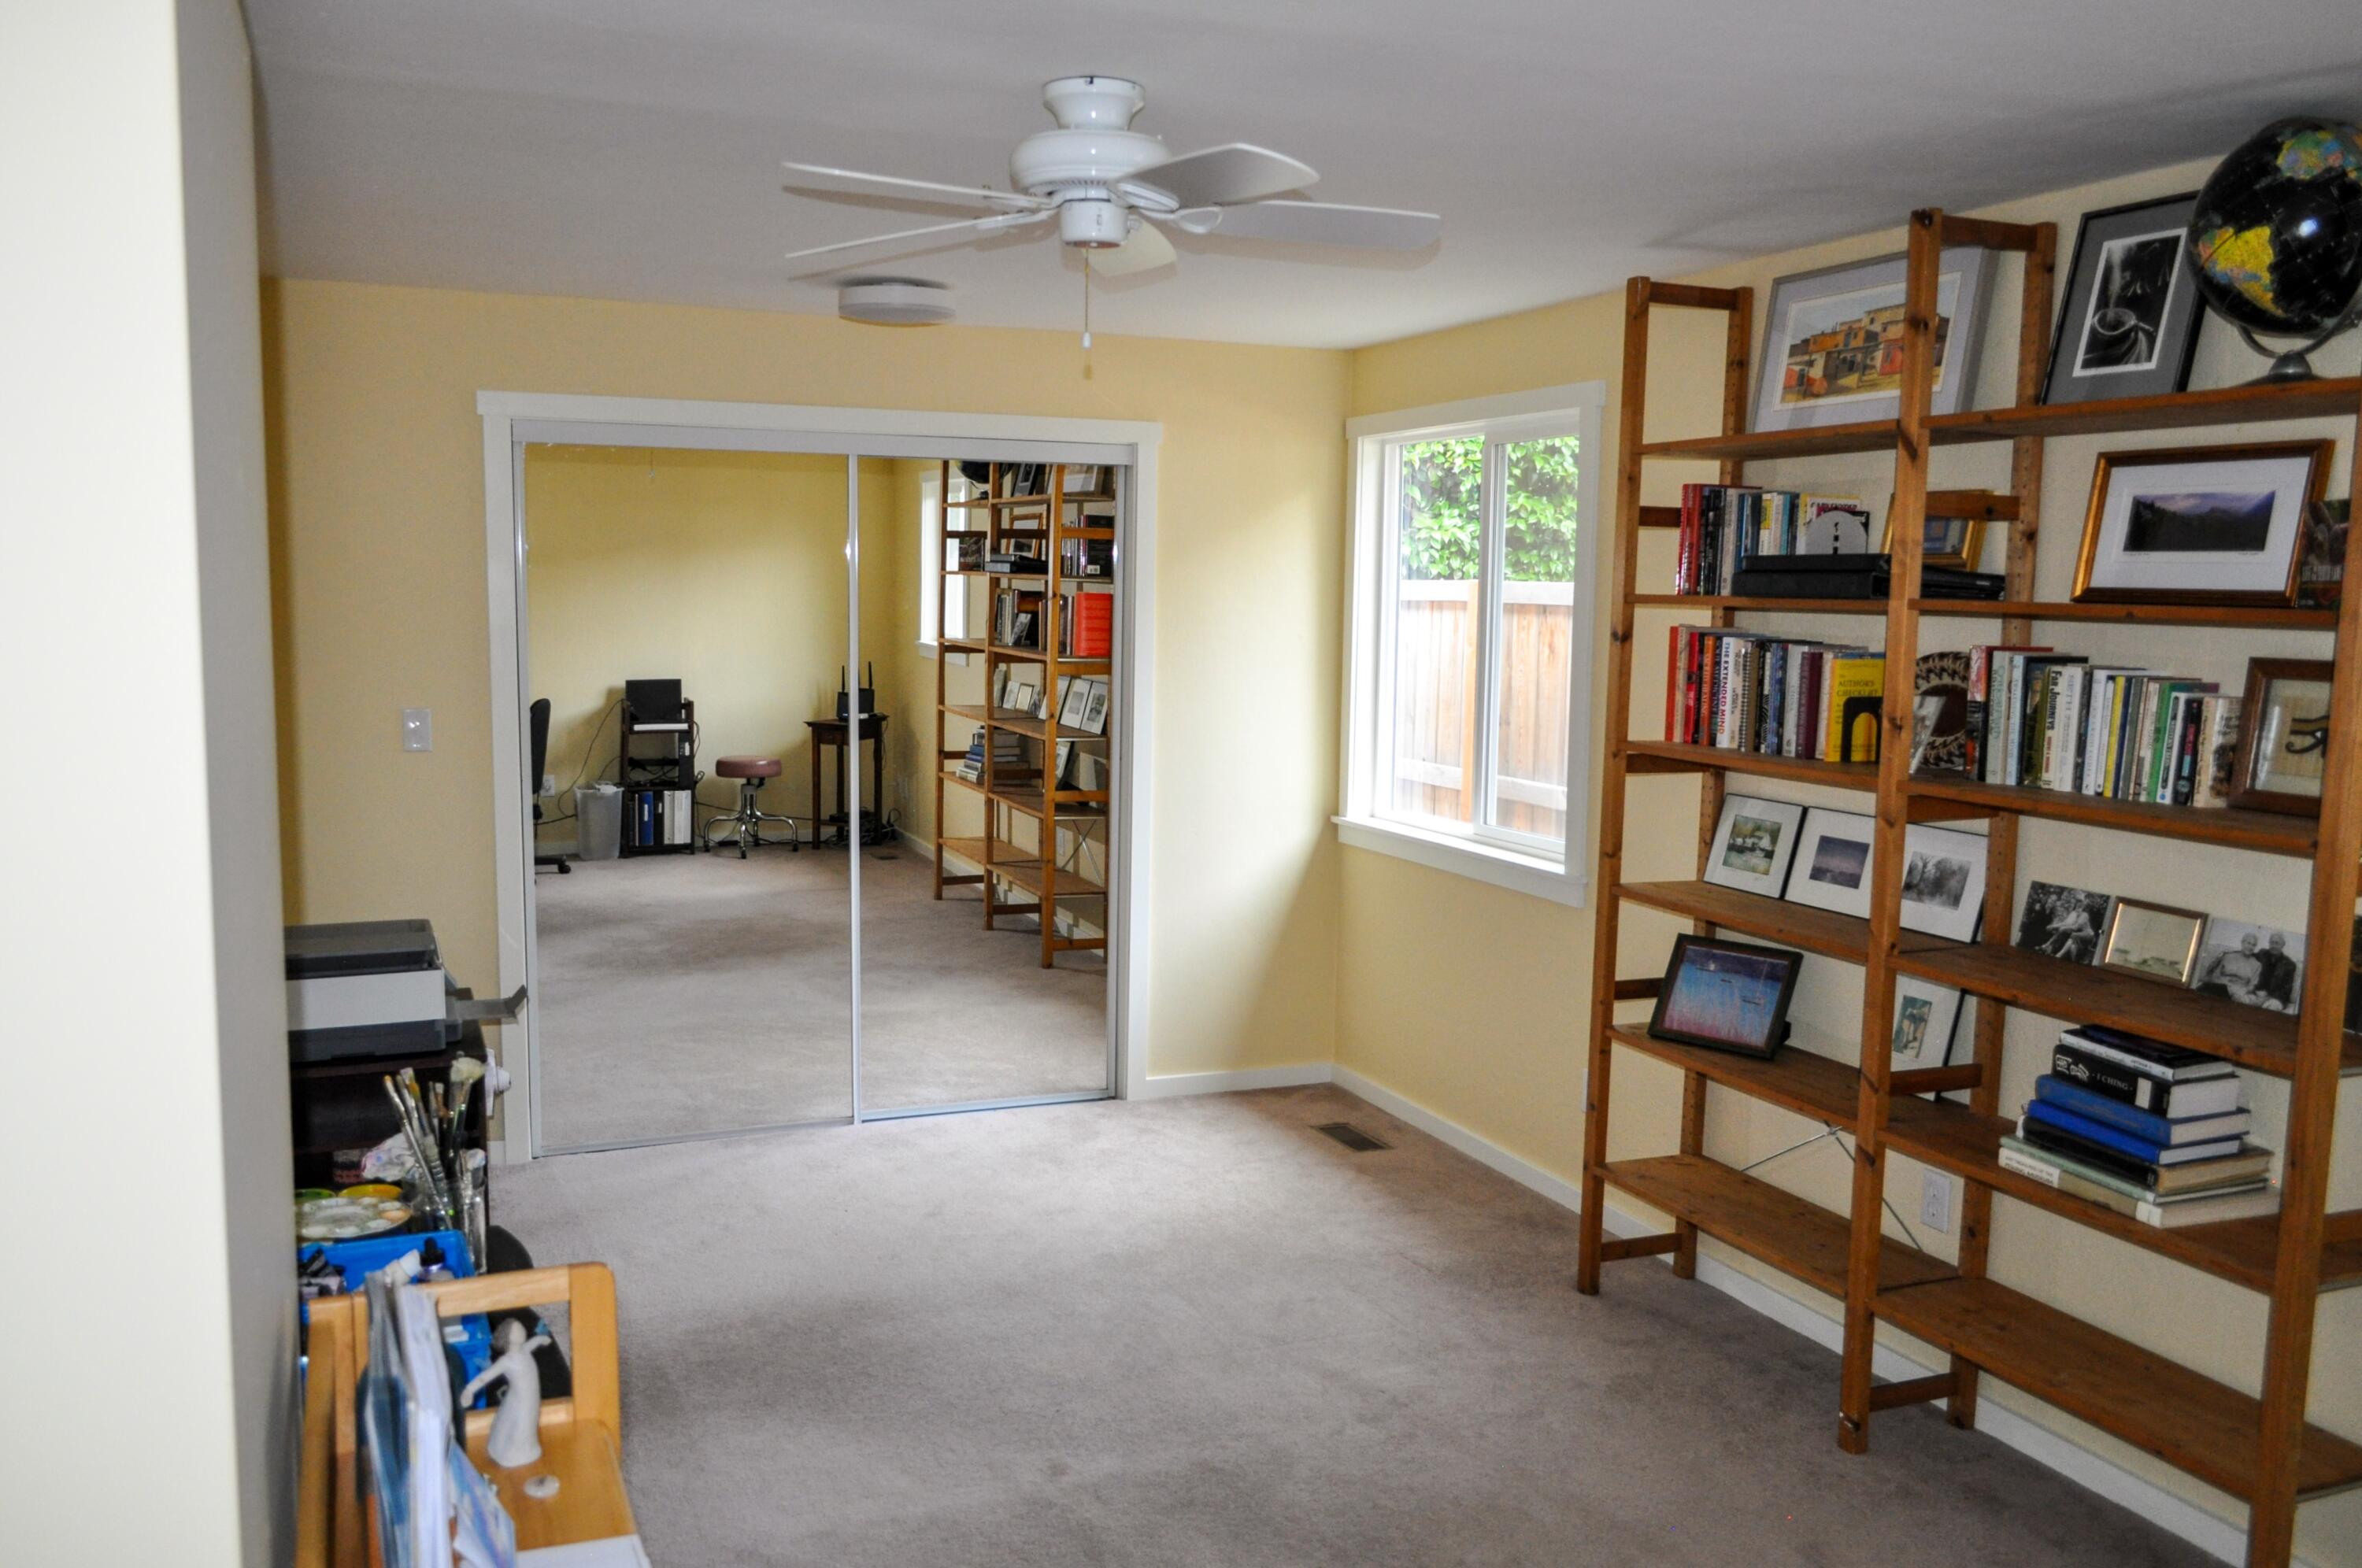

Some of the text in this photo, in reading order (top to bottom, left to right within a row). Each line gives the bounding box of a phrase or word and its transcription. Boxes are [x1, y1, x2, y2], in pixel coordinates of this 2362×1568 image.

[1720, 660, 1730, 707] EXTENDED
[1718, 709, 1727, 734] MIND
[2101, 1074, 2128, 1090] CHING
